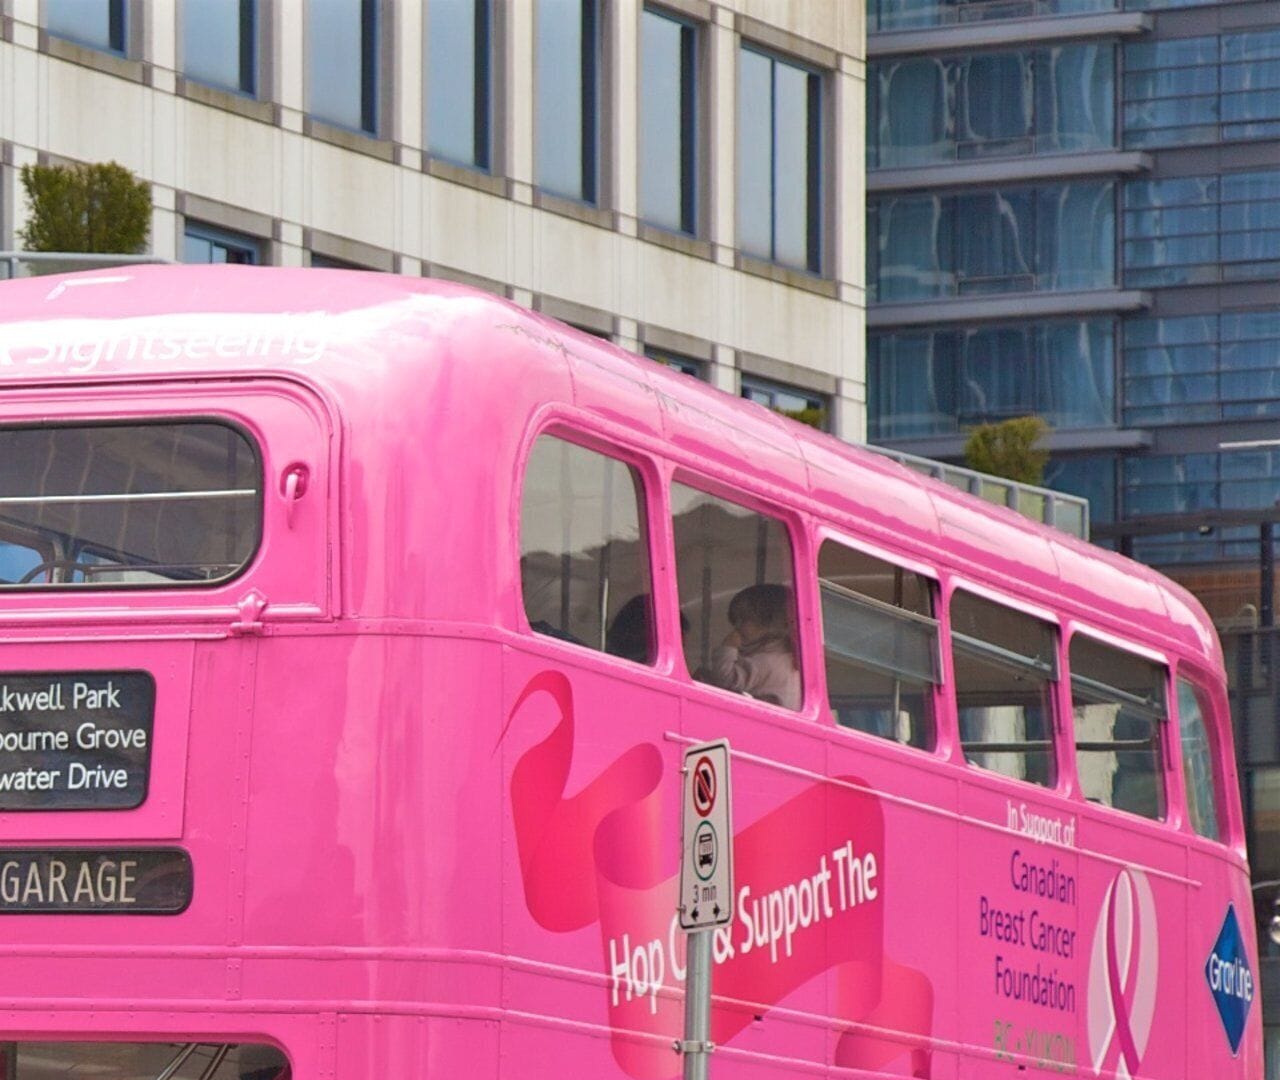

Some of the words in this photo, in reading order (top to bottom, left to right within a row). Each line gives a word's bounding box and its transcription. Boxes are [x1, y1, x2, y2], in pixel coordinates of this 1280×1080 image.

[72, 681, 121, 709] Park
[76, 722, 147, 750] Grove
[68, 762, 128, 790] Drive
[1020, 803, 1062, 845] Support
[0, 860, 137, 903] GARAGE
[1010, 850, 1075, 906] Canadian
[609, 934, 665, 1015] Hop
[739, 857, 833, 963] Support
[833, 840, 878, 912] The
[979, 895, 1026, 947] Breast
[1029, 910, 1075, 959] Cancer
[995, 956, 1075, 1013] Foundation
